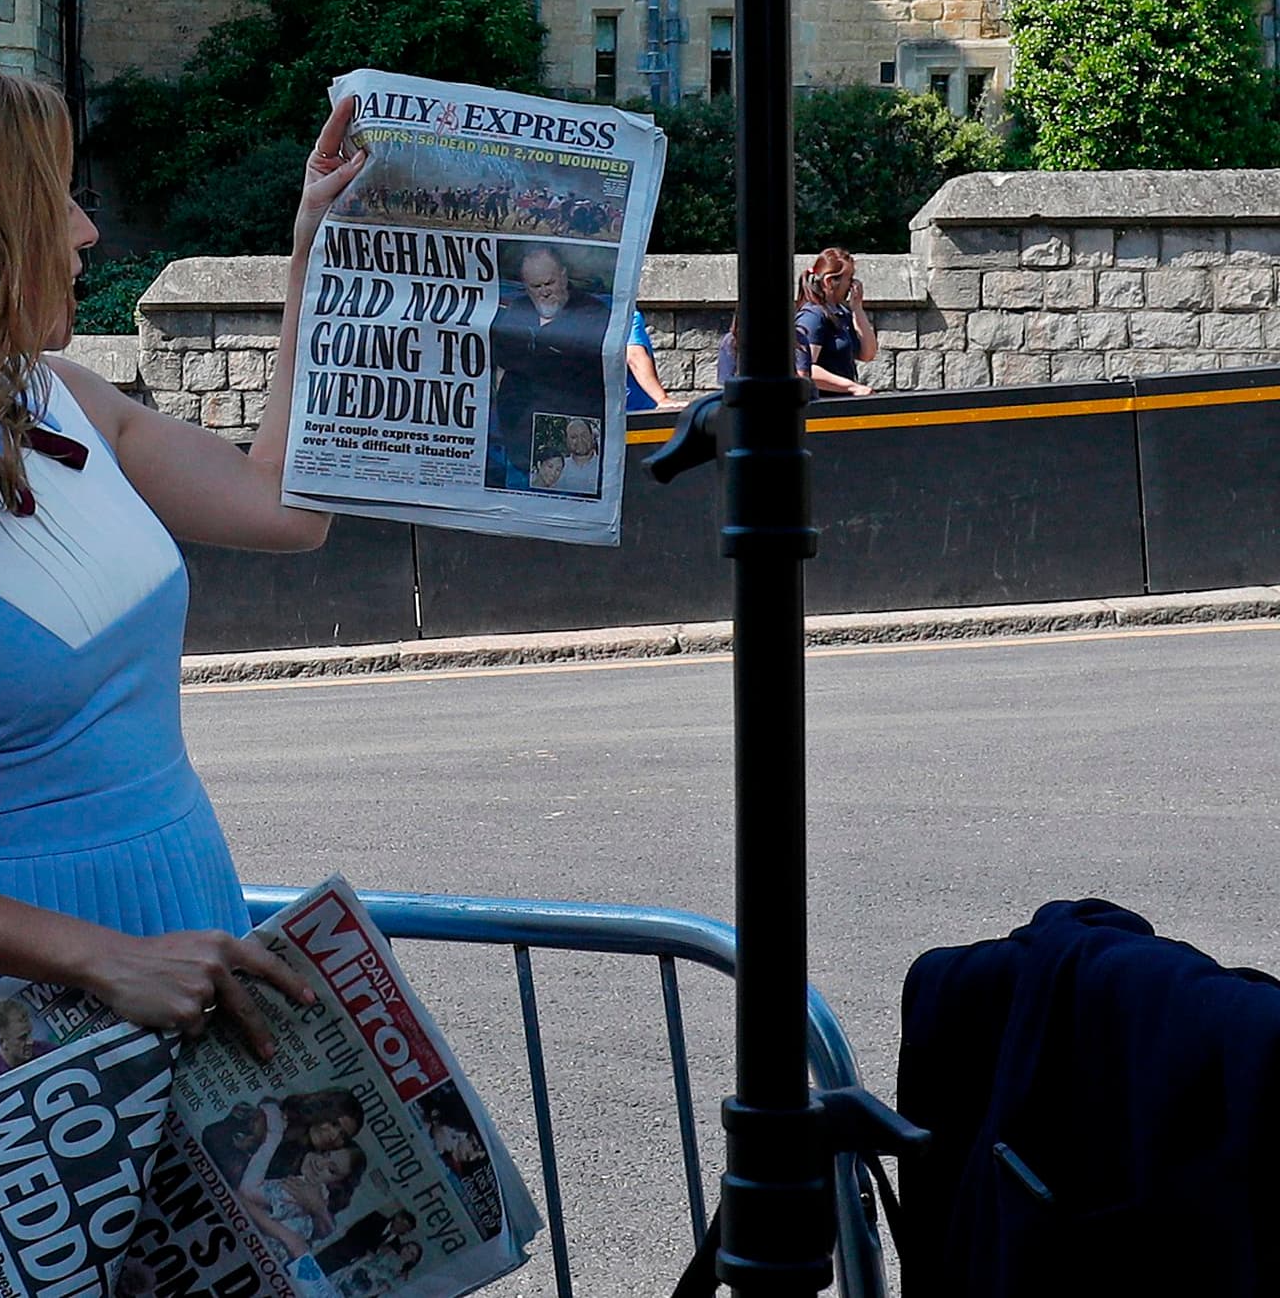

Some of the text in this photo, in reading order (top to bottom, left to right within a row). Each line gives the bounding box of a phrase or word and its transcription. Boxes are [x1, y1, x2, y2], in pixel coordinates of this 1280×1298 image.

[461, 104, 617, 150] EXPRESS
[418, 134, 435, 145] 58
[440, 138, 476, 152] DEAD
[481, 144, 510, 158] AND
[514, 147, 555, 164] 2,700
[558, 153, 629, 173] WOUNDED
[323, 226, 495, 282] MEGHAN'S
[314, 273, 484, 327] DAD NOT
[310, 321, 486, 378] GOING TO
[306, 371, 477, 429] WEDDING
[303, 437, 328, 447] over
[362, 440, 412, 455] difficult
[304, 420, 476, 446] Royal couple express sorrow
[287, 895, 430, 1085] Mirror
[359, 952, 400, 1004] DAILY
[200, 1042, 243, 1097] night stole
[223, 1043, 253, 1076] saved
[243, 1071, 264, 1093] her
[267, 1072, 286, 1091] for
[274, 1048, 298, 1078] victim
[172, 1072, 204, 1112] Awards
[192, 1065, 216, 1091] first
[206, 1089, 227, 1114] ever
[35, 1067, 142, 1245] GO TO
[313, 1017, 364, 1079] truly
[349, 1080, 423, 1189] amazing,
[413, 1180, 465, 1255] Freya
[181, 1136, 296, 1296] WEDDING SHOCK
